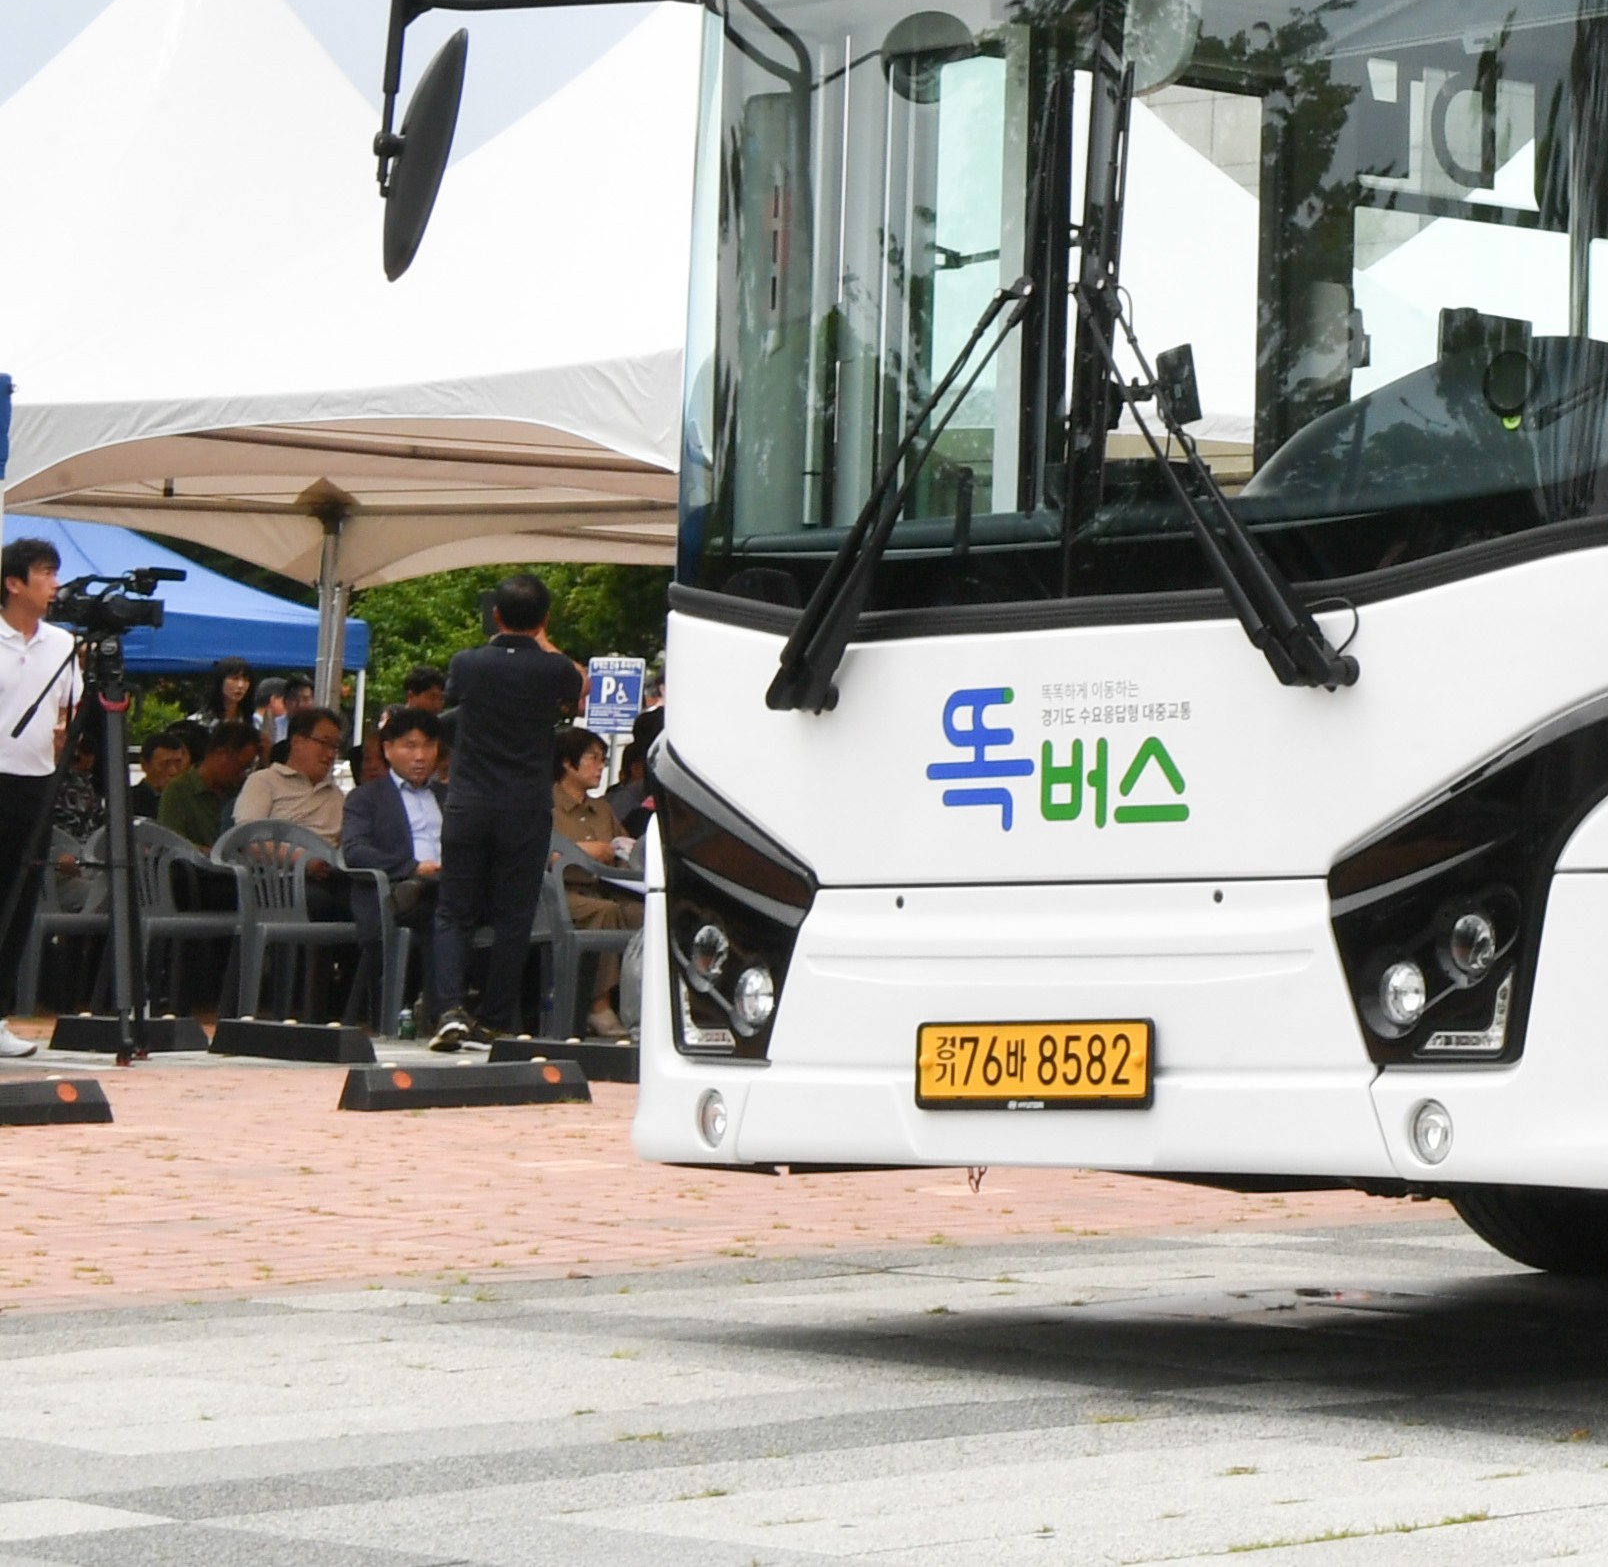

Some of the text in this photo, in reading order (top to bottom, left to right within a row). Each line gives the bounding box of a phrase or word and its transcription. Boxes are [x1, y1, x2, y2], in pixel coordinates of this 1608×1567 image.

[601, 676, 616, 704] P
[1041, 680, 1139, 701] 똑똑하게 이동하는
[1041, 701, 1191, 727] 경기도 수요응답형 대중교통
[926, 686, 1190, 832] 똑버스
[935, 1033, 1132, 1087] 경기 76바 8582
